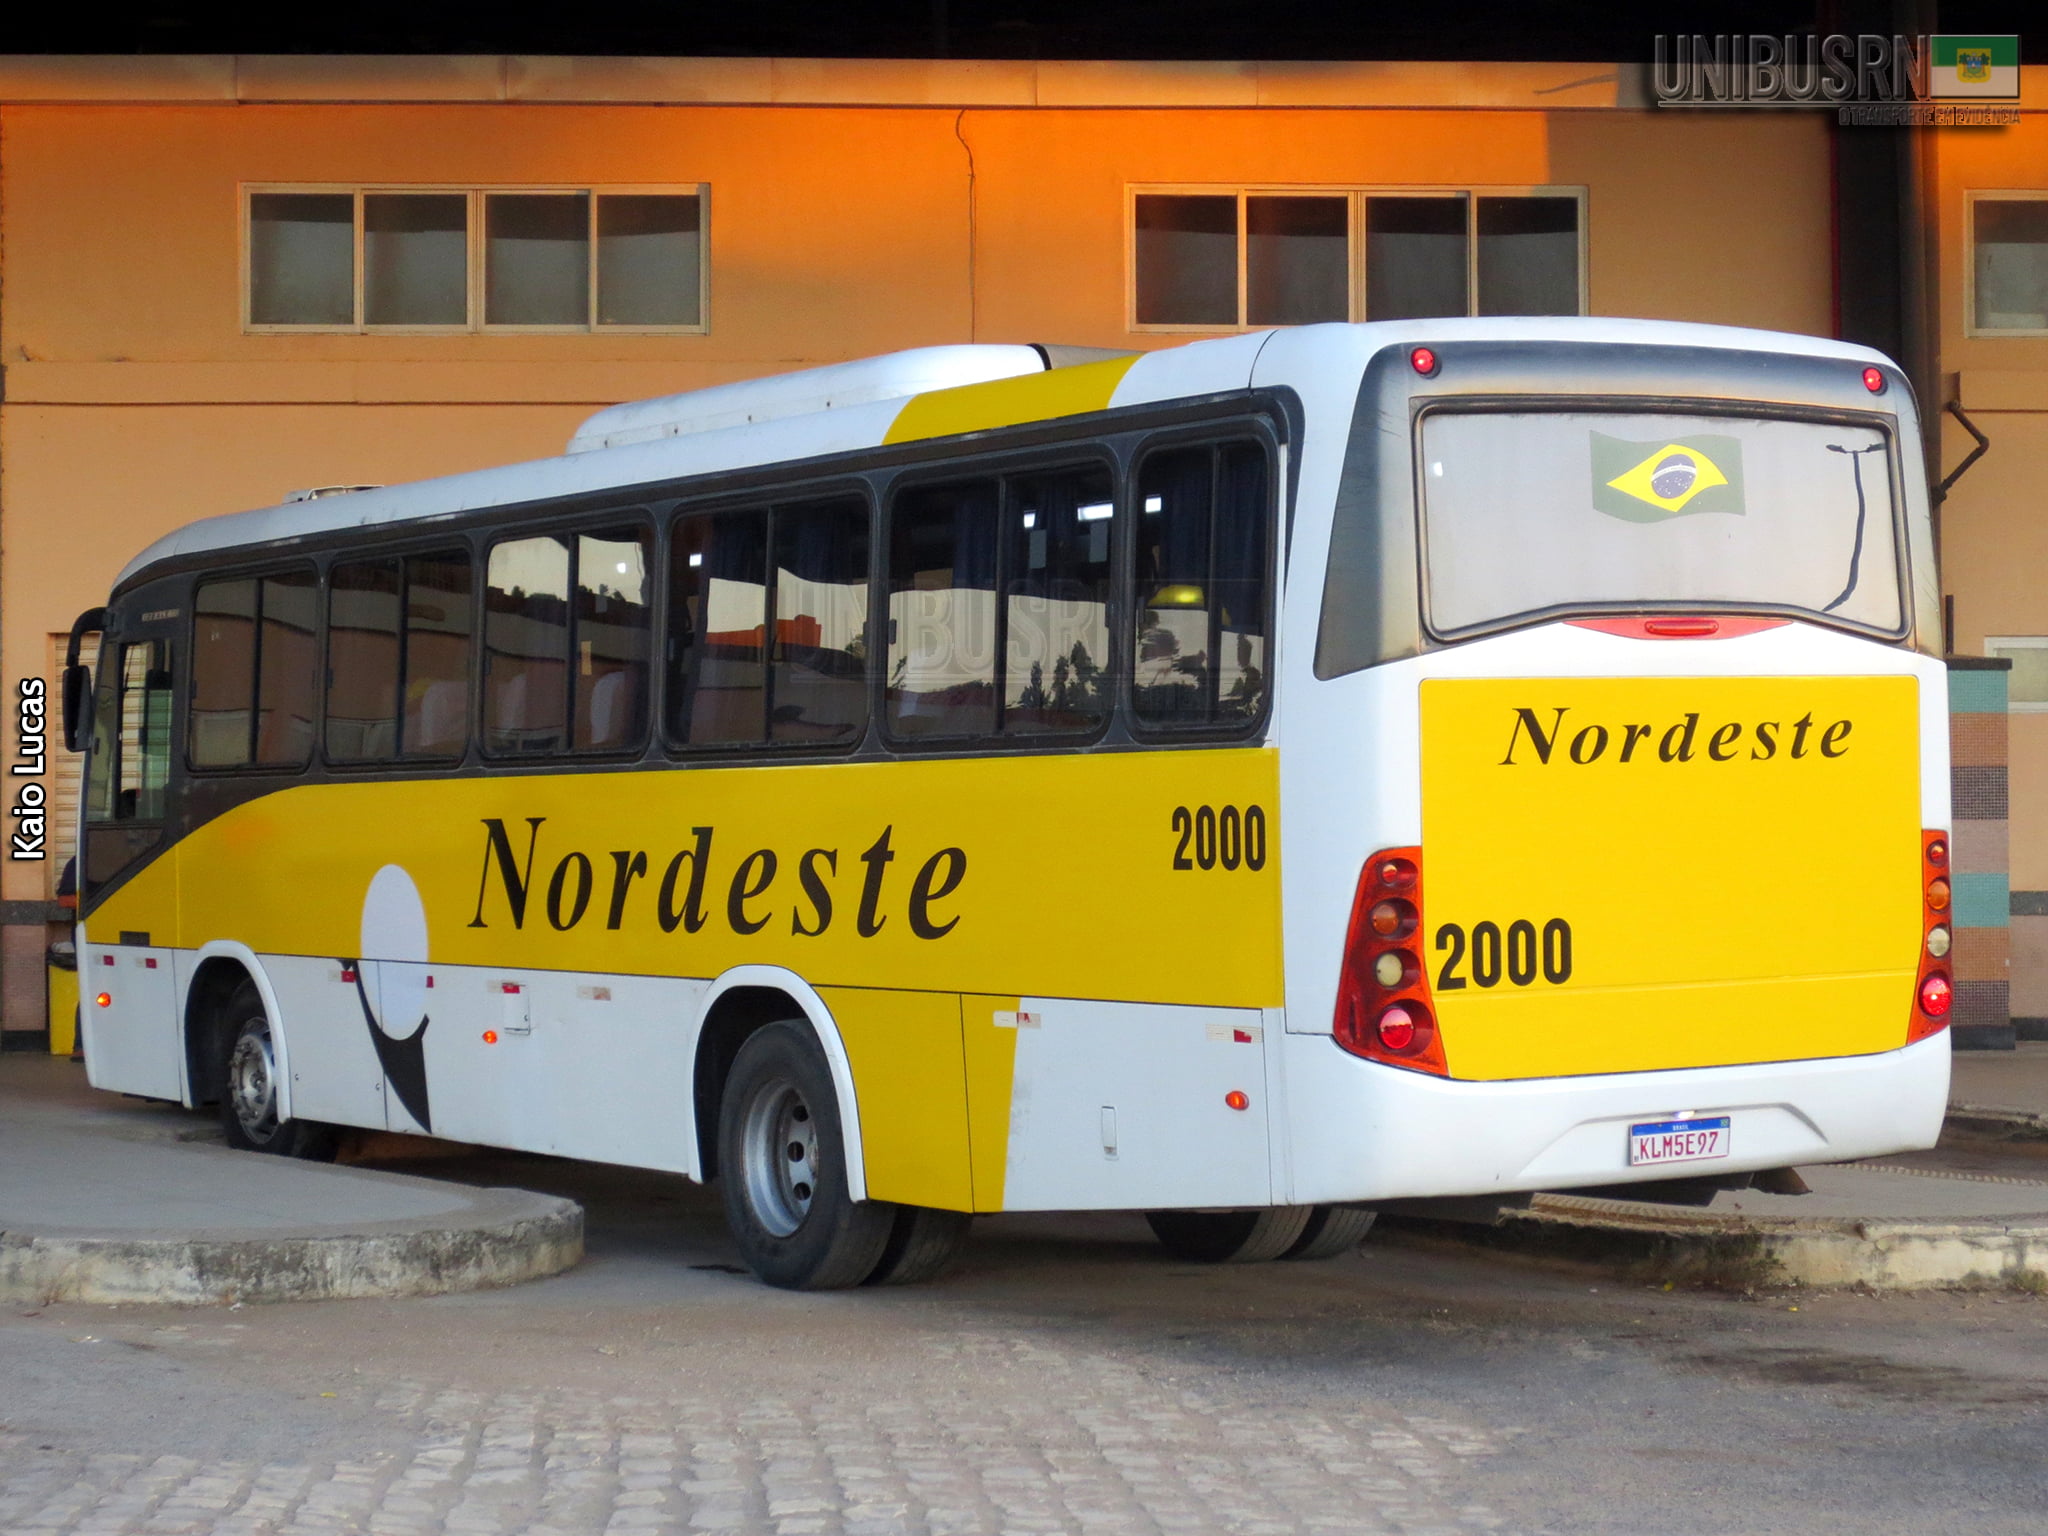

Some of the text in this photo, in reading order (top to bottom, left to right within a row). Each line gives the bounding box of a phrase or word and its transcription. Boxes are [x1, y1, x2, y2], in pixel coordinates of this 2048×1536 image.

[1498, 706, 1854, 766] Nordeste
[1172, 805, 1267, 871] 2000
[467, 817, 968, 940] Nordeste
[1435, 918, 1573, 991] 2000
[1640, 1131, 1719, 1160] KLM5E97
